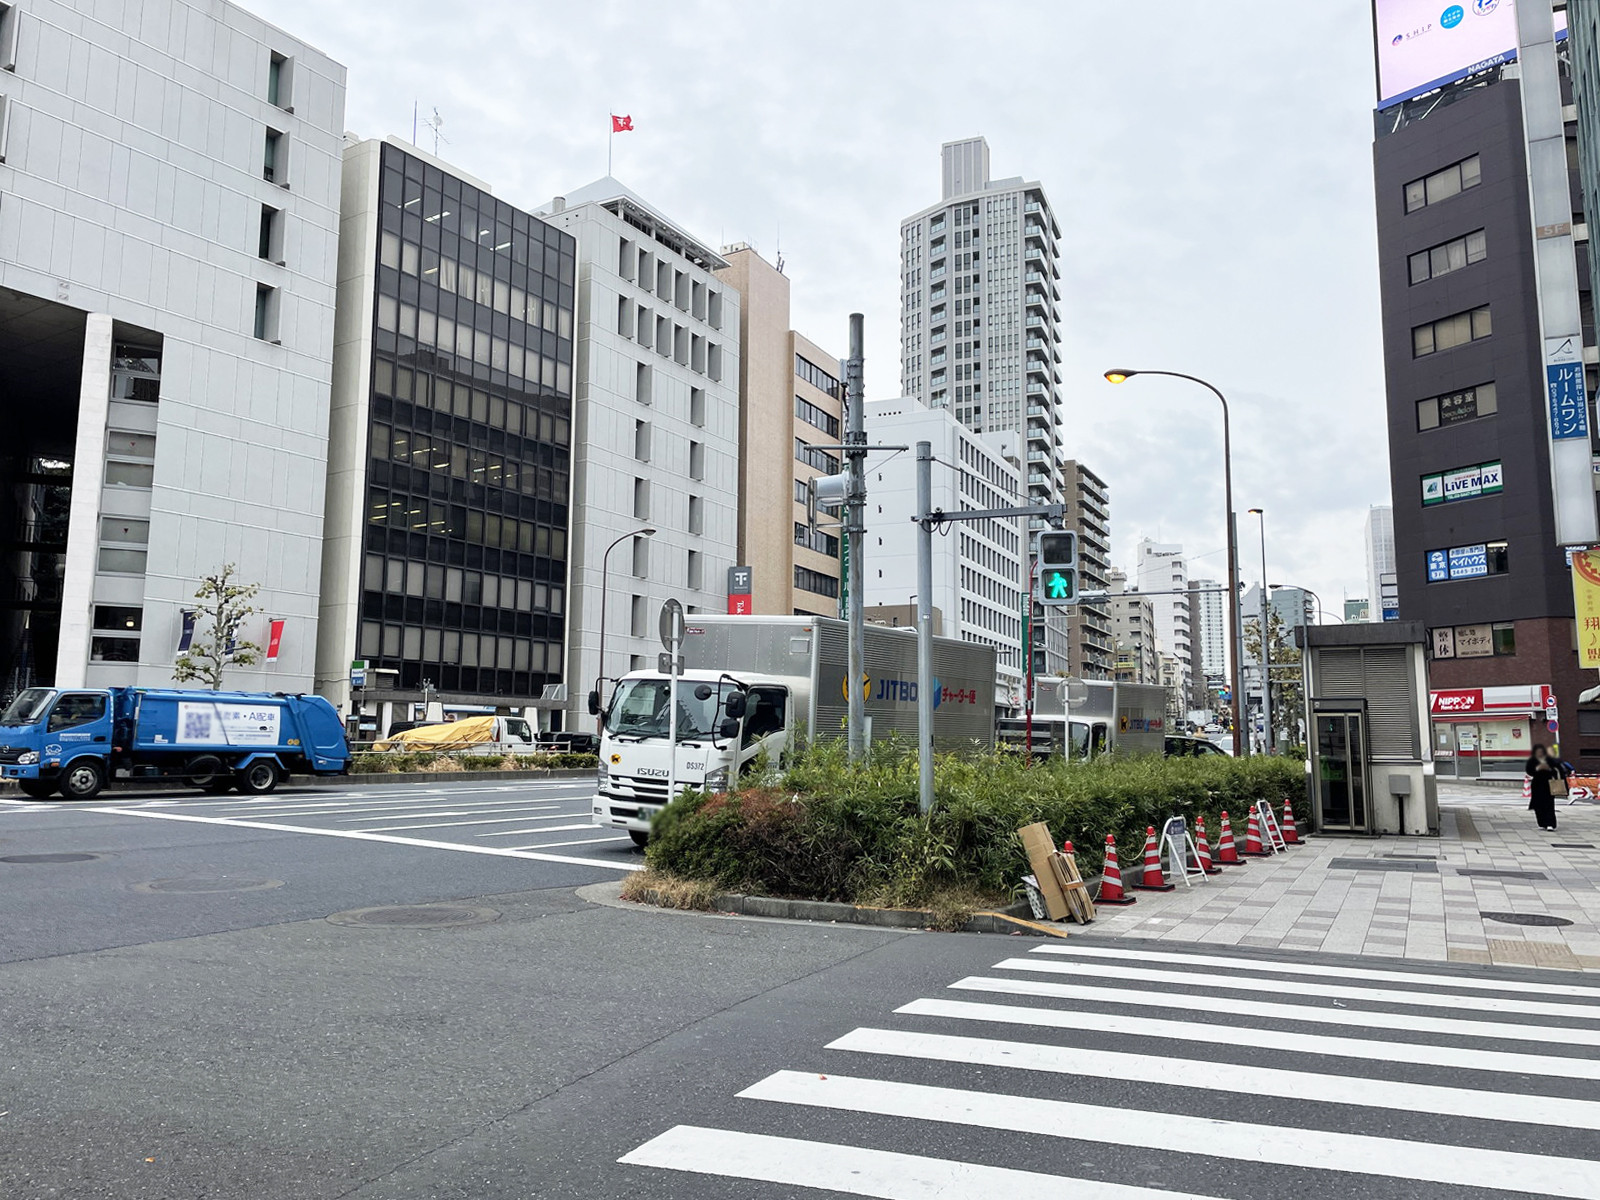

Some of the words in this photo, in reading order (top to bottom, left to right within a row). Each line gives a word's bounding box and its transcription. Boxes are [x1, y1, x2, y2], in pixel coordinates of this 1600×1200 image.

[1406, 24, 1432, 38] SHIP
[1468, 54, 1505, 74] NAGATA
[1442, 392, 1474, 409] 美容室
[1558, 368, 1577, 434] ルームワン
[1445, 479, 1468, 492] LiVE
[1471, 473, 1499, 487] MAX
[1430, 562, 1446, 570] 東京
[1450, 555, 1486, 567] ベイハウス
[1438, 631, 1449, 656] 整体
[876, 679, 919, 702] JITBO
[942, 687, 977, 704] チャーター便
[1438, 696, 1475, 706] NIPPON
[637, 767, 669, 777] ISUZU
[686, 761, 705, 771] DS372
